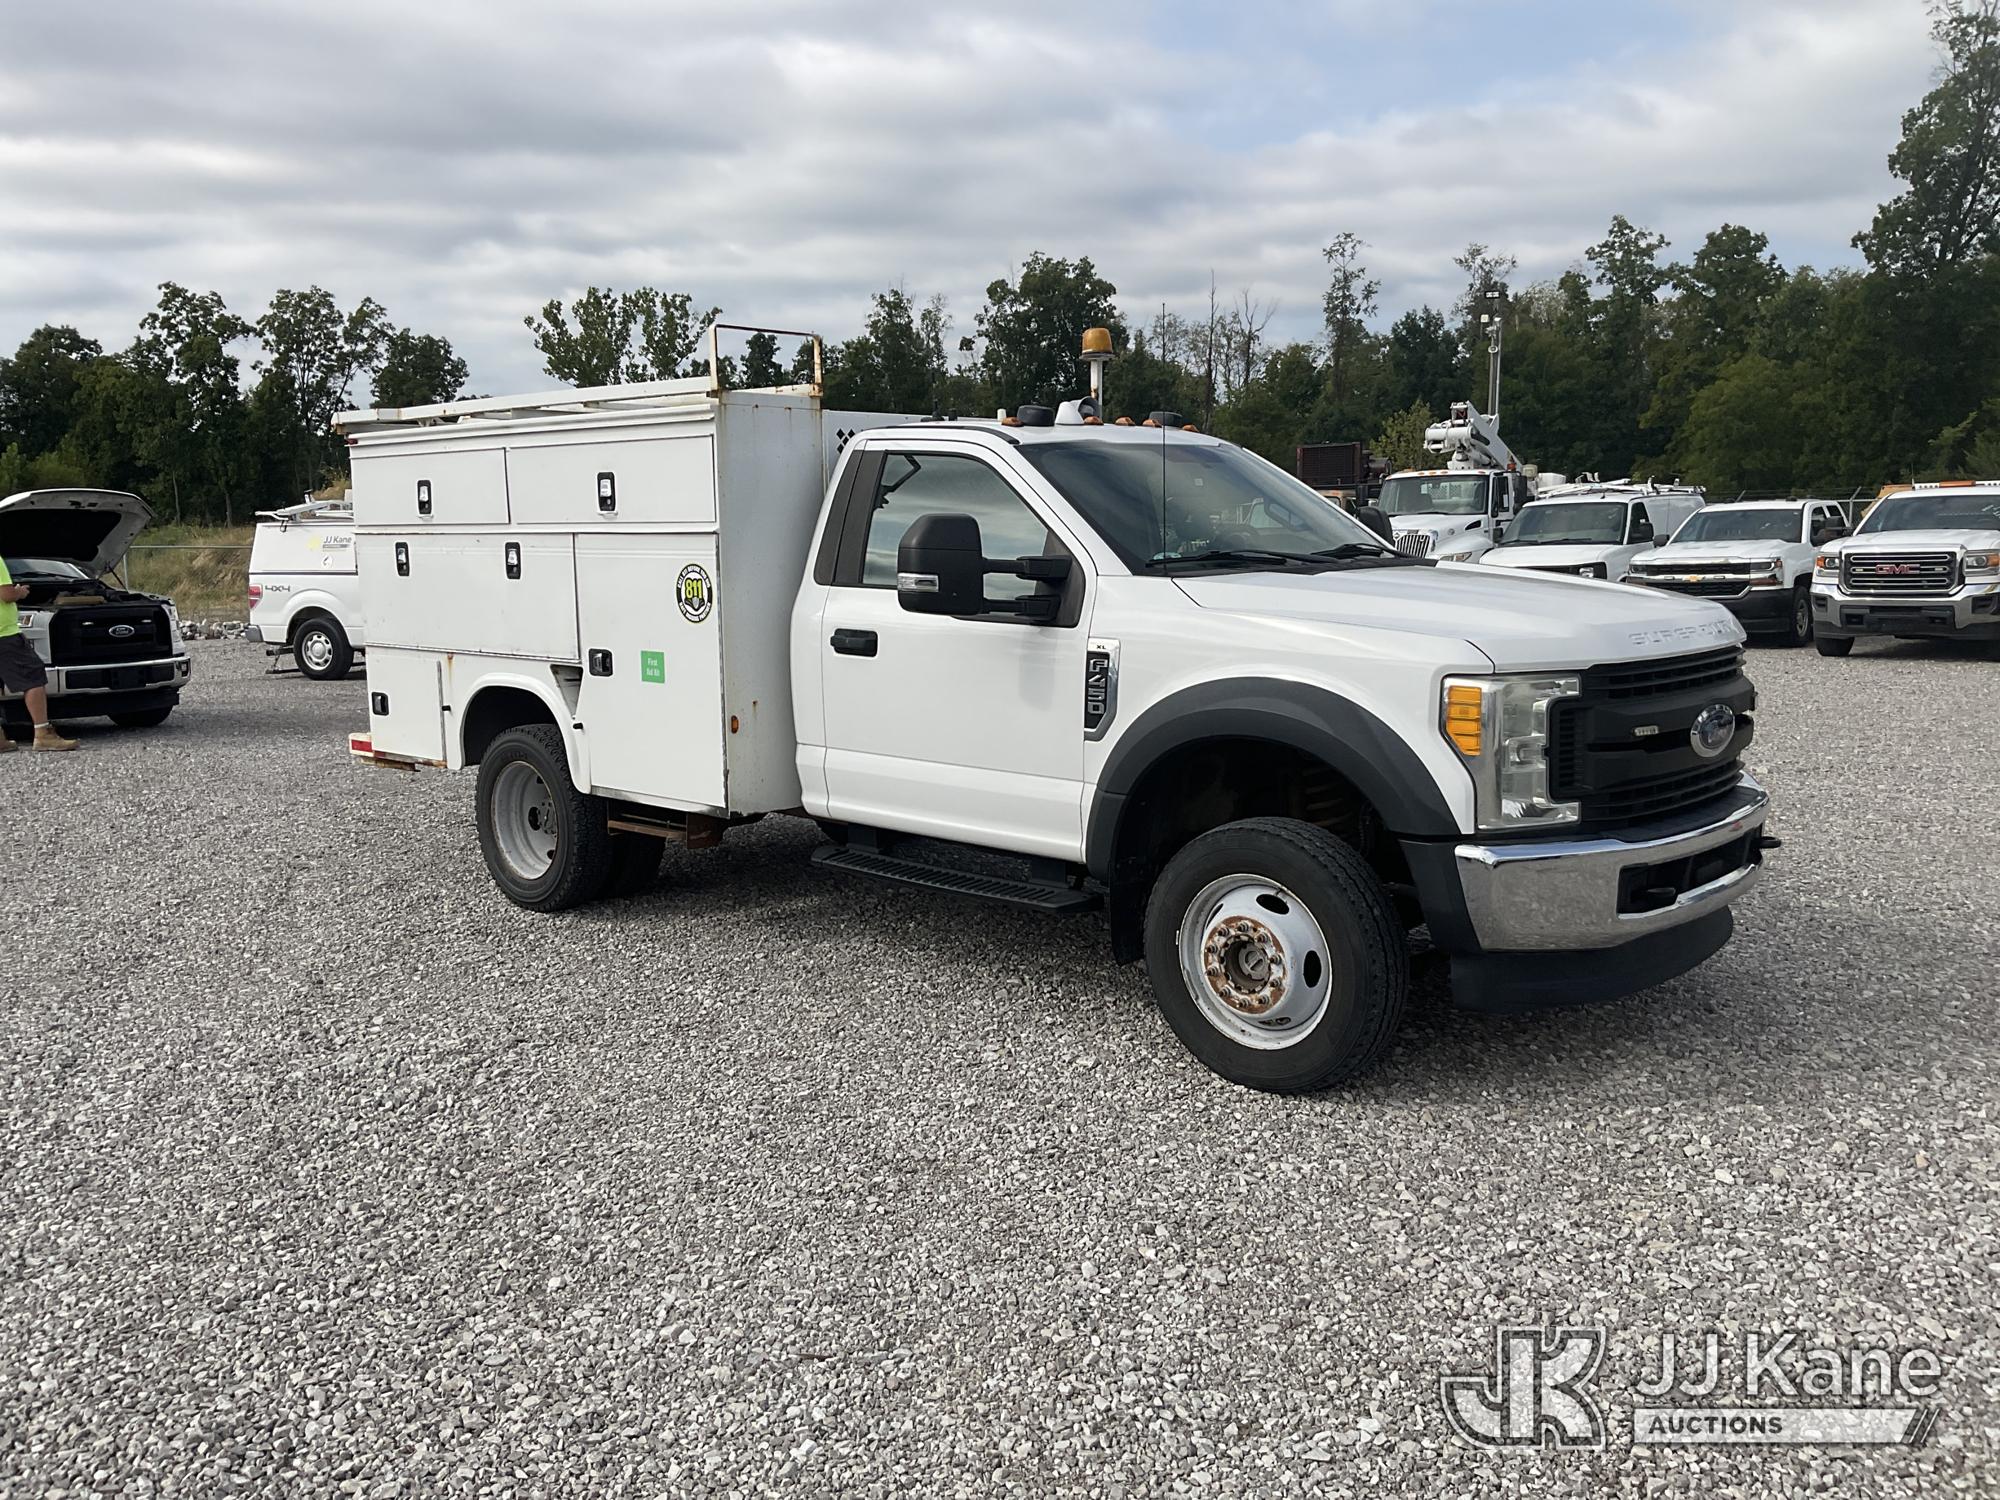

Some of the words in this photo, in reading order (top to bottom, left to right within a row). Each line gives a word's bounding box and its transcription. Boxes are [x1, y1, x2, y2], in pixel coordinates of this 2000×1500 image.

[333, 535, 352, 544] Kane
[1875, 563, 1920, 575] GMC
[685, 578, 703, 599] 811
